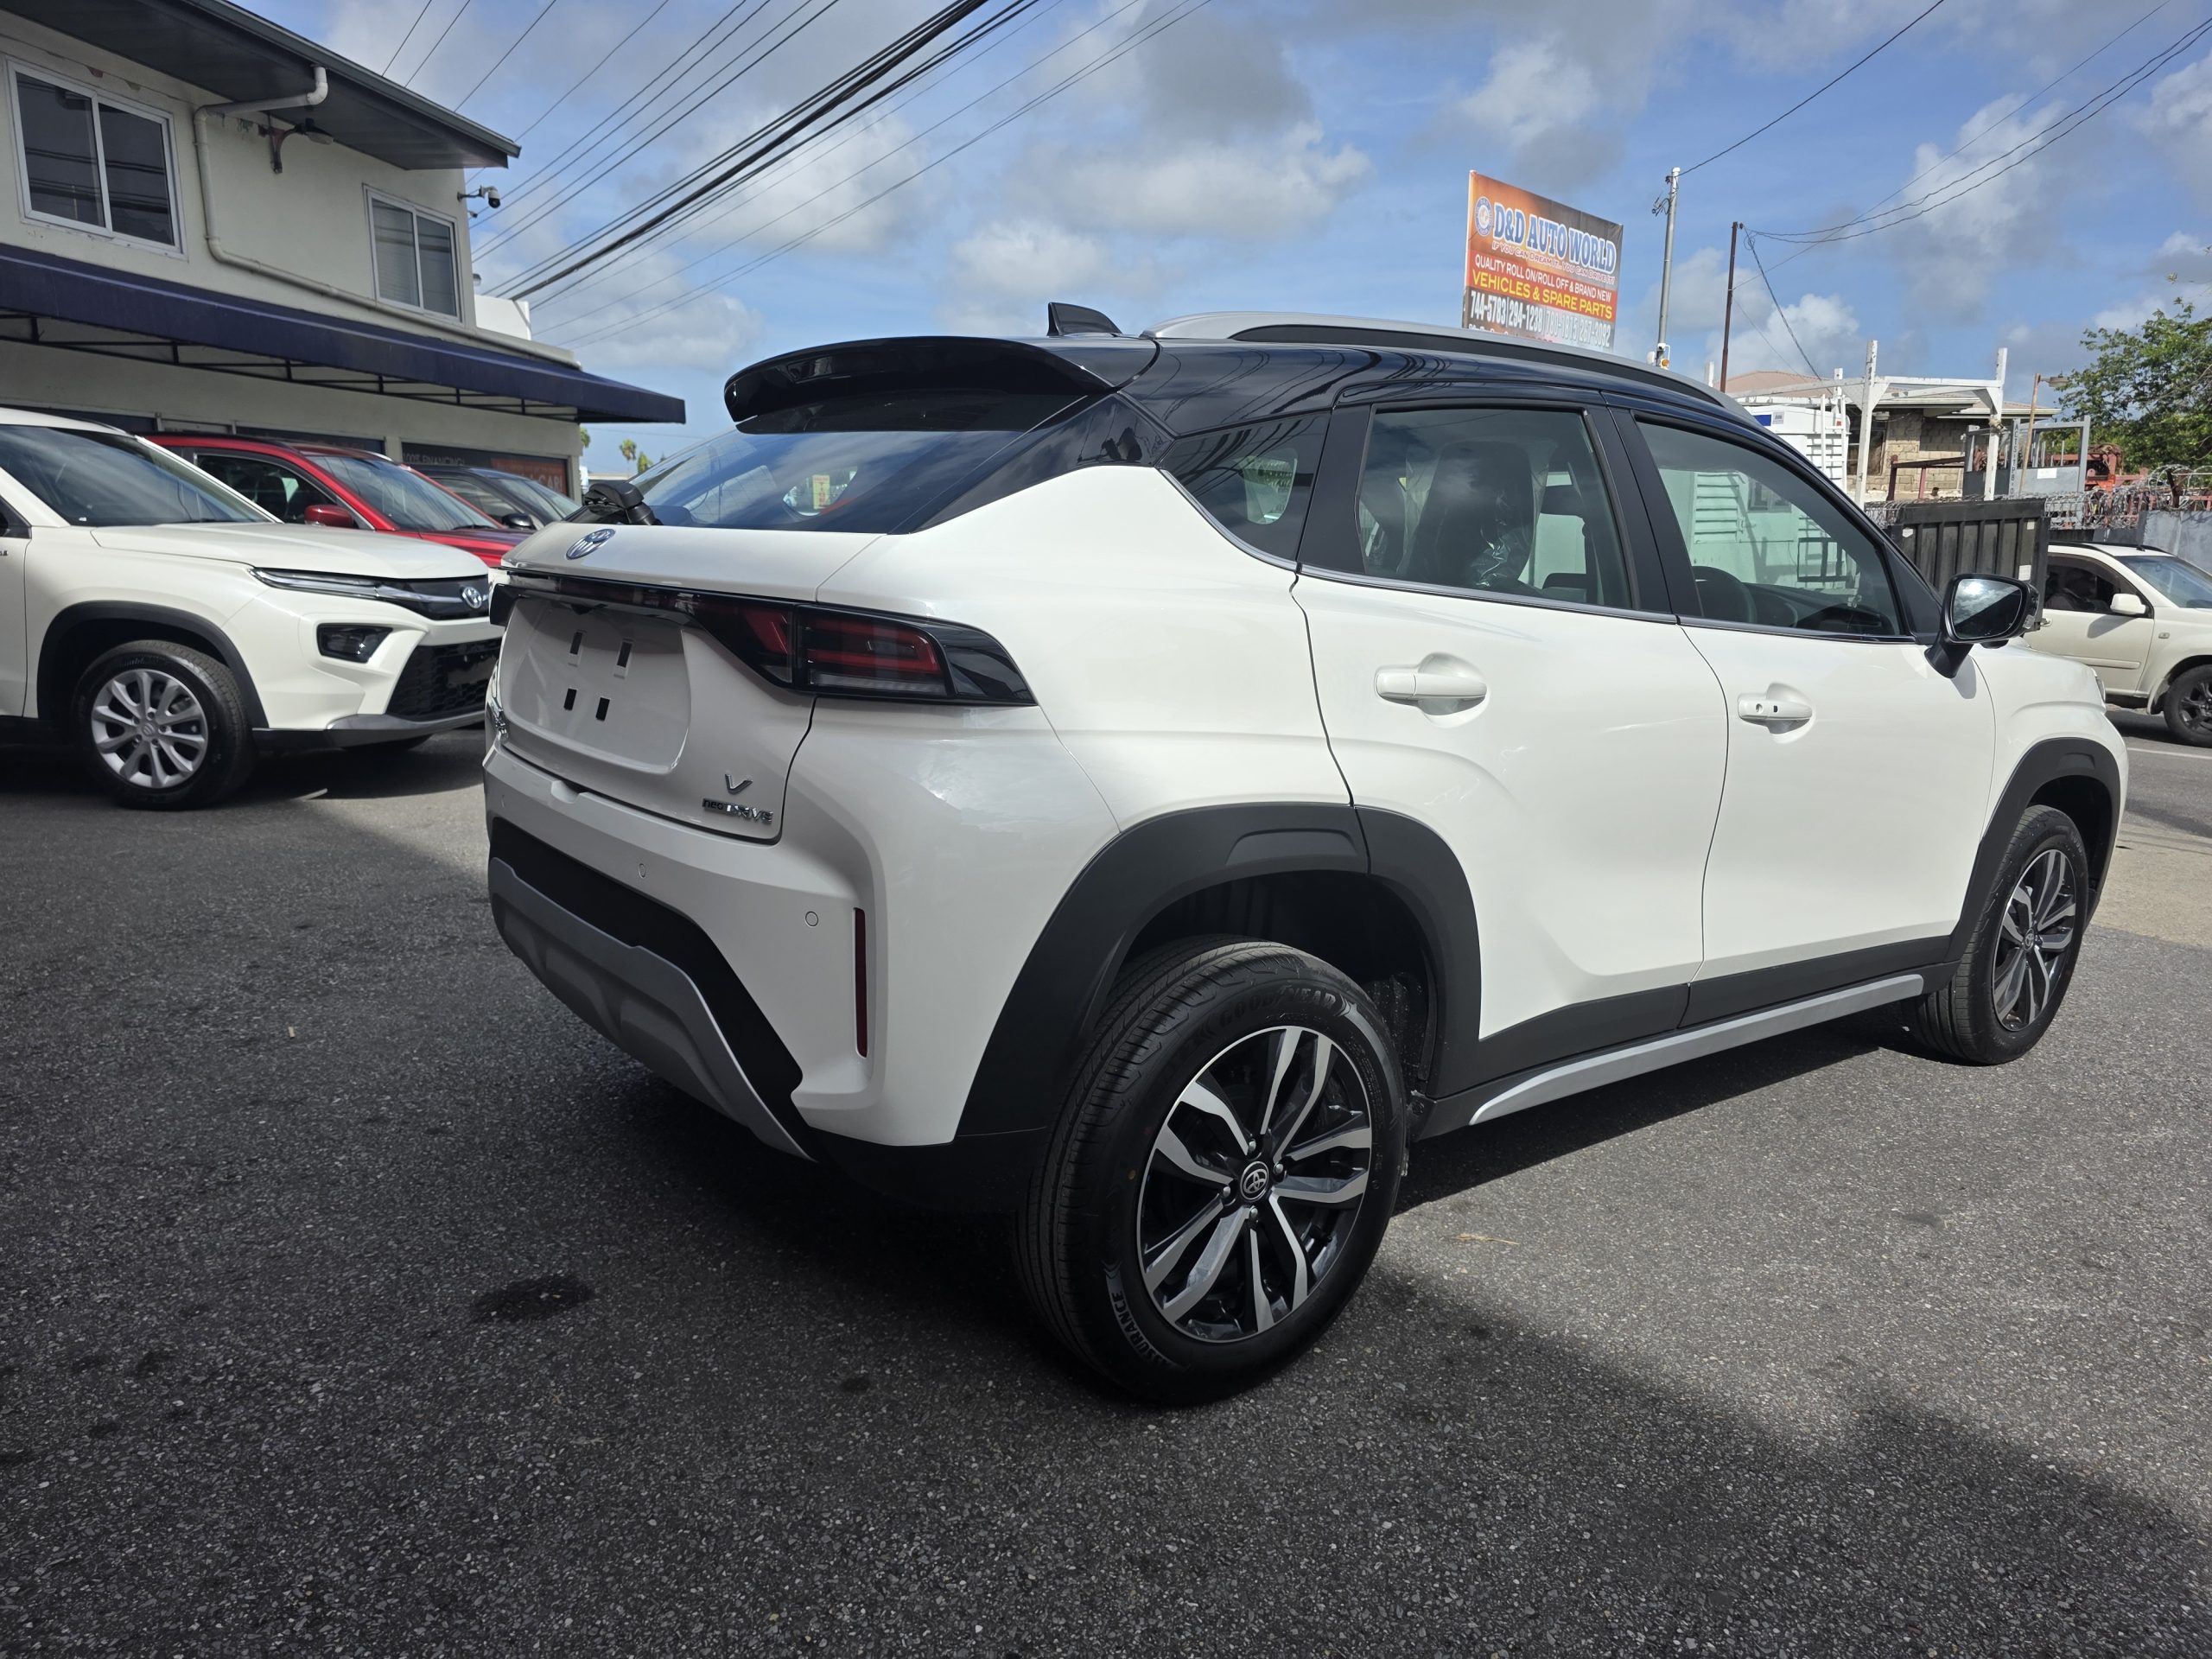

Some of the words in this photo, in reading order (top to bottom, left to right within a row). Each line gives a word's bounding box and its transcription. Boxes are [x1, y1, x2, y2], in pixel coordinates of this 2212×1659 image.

[1492, 241, 1499, 251] IF
[1500, 244, 1514, 256] YOU
[1515, 247, 1529, 258] CAN
[1493, 202, 1526, 245] D&D
[1526, 213, 1567, 259] AUTO
[1568, 227, 1617, 274] WORLD
[1472, 270, 1531, 298] VEHICLES
[1532, 286, 1541, 301] &
[1542, 289, 1578, 310] SPARE
[1579, 298, 1612, 319] PARTS
[1475, 254, 1505, 273] QUALITY
[1506, 263, 1524, 279] ROLL
[1525, 268, 1554, 287] ON/ROLL
[1555, 277, 1569, 290] OFF
[1569, 281, 1574, 293] &
[1574, 283, 1596, 299] BRAND
[1597, 288, 1611, 303] NEW
